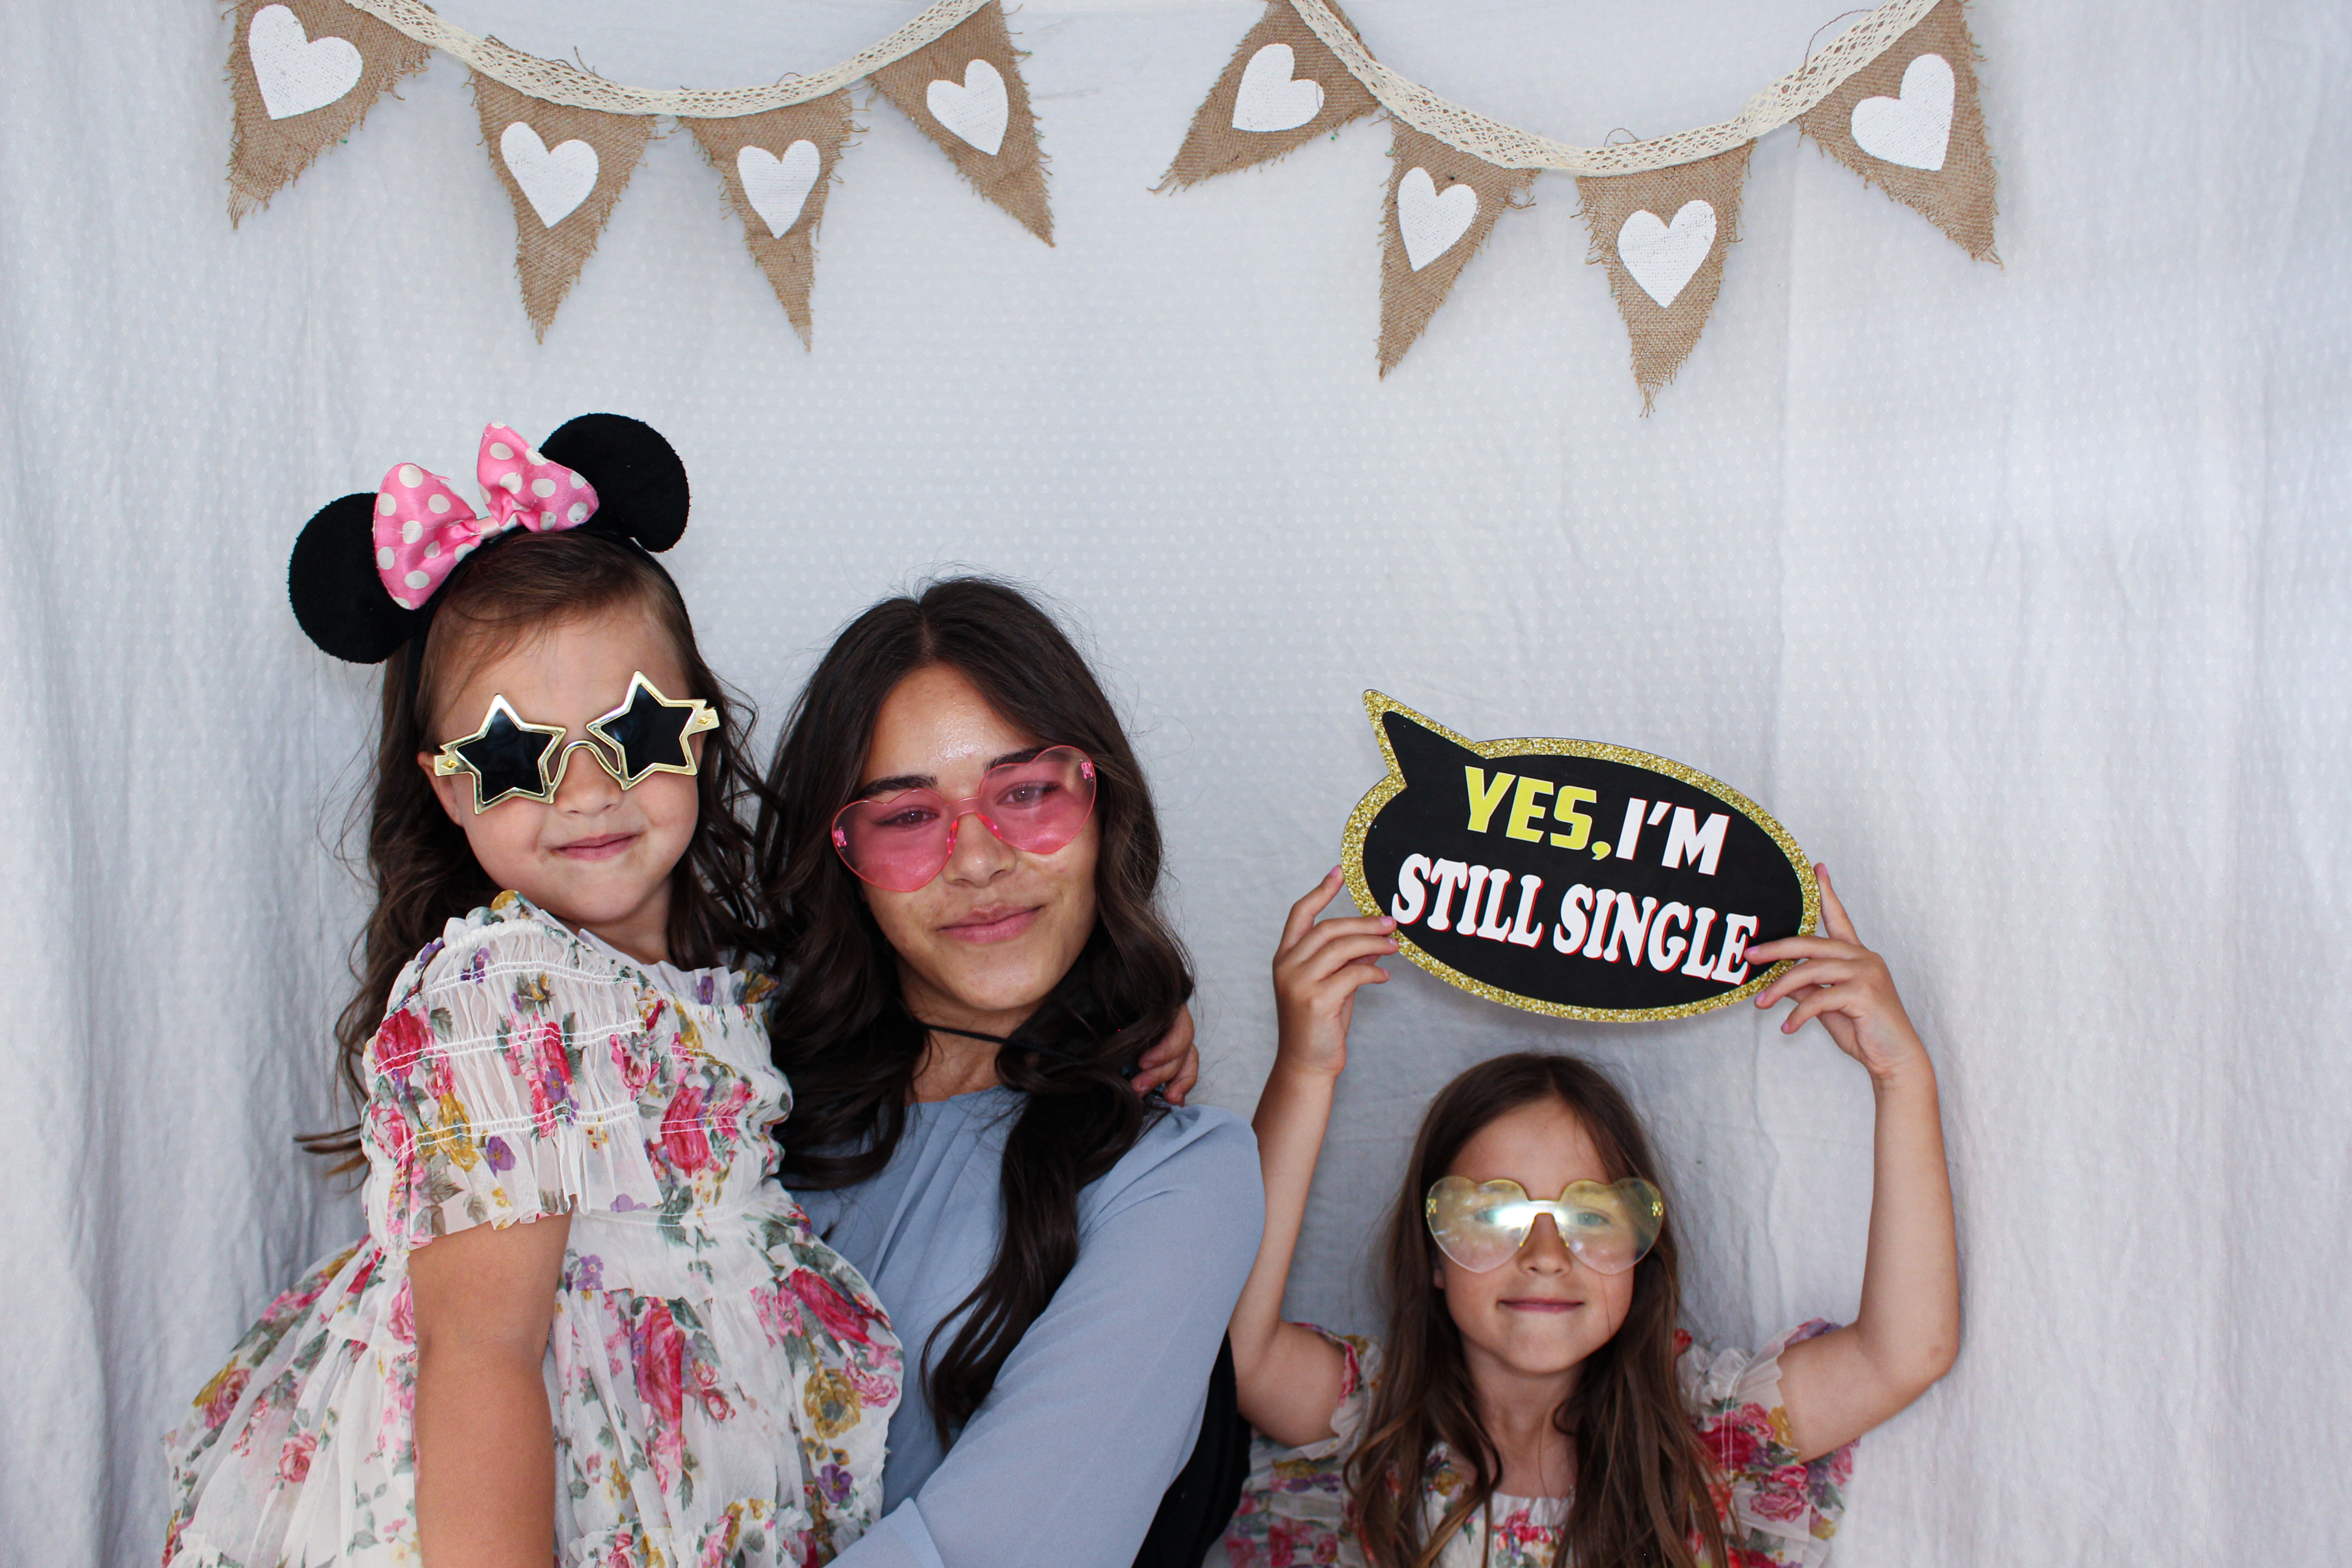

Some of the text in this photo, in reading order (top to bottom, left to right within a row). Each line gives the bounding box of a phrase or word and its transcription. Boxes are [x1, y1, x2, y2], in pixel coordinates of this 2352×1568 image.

[1465, 765, 1730, 876] YES, I'M
[1392, 853, 1759, 986] STILL SINGLE
